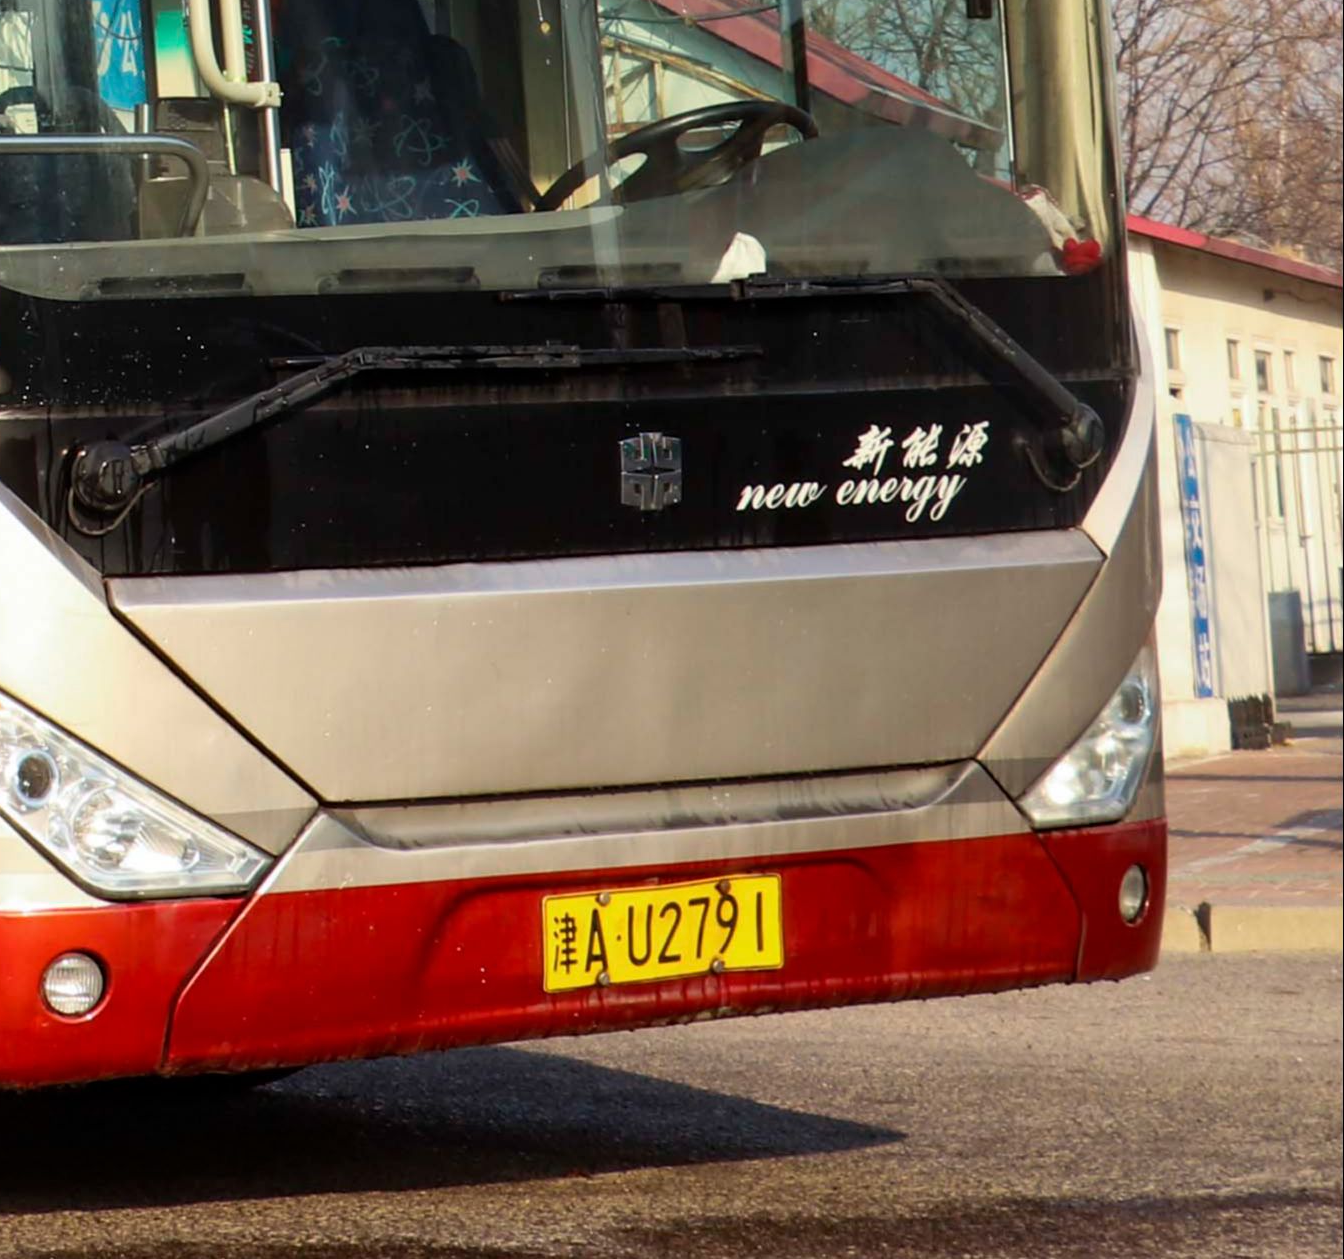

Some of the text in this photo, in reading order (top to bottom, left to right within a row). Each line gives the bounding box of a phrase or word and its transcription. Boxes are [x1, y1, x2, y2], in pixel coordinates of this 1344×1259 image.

[842, 420, 991, 476] 新能源
[735, 472, 968, 524] new energy
